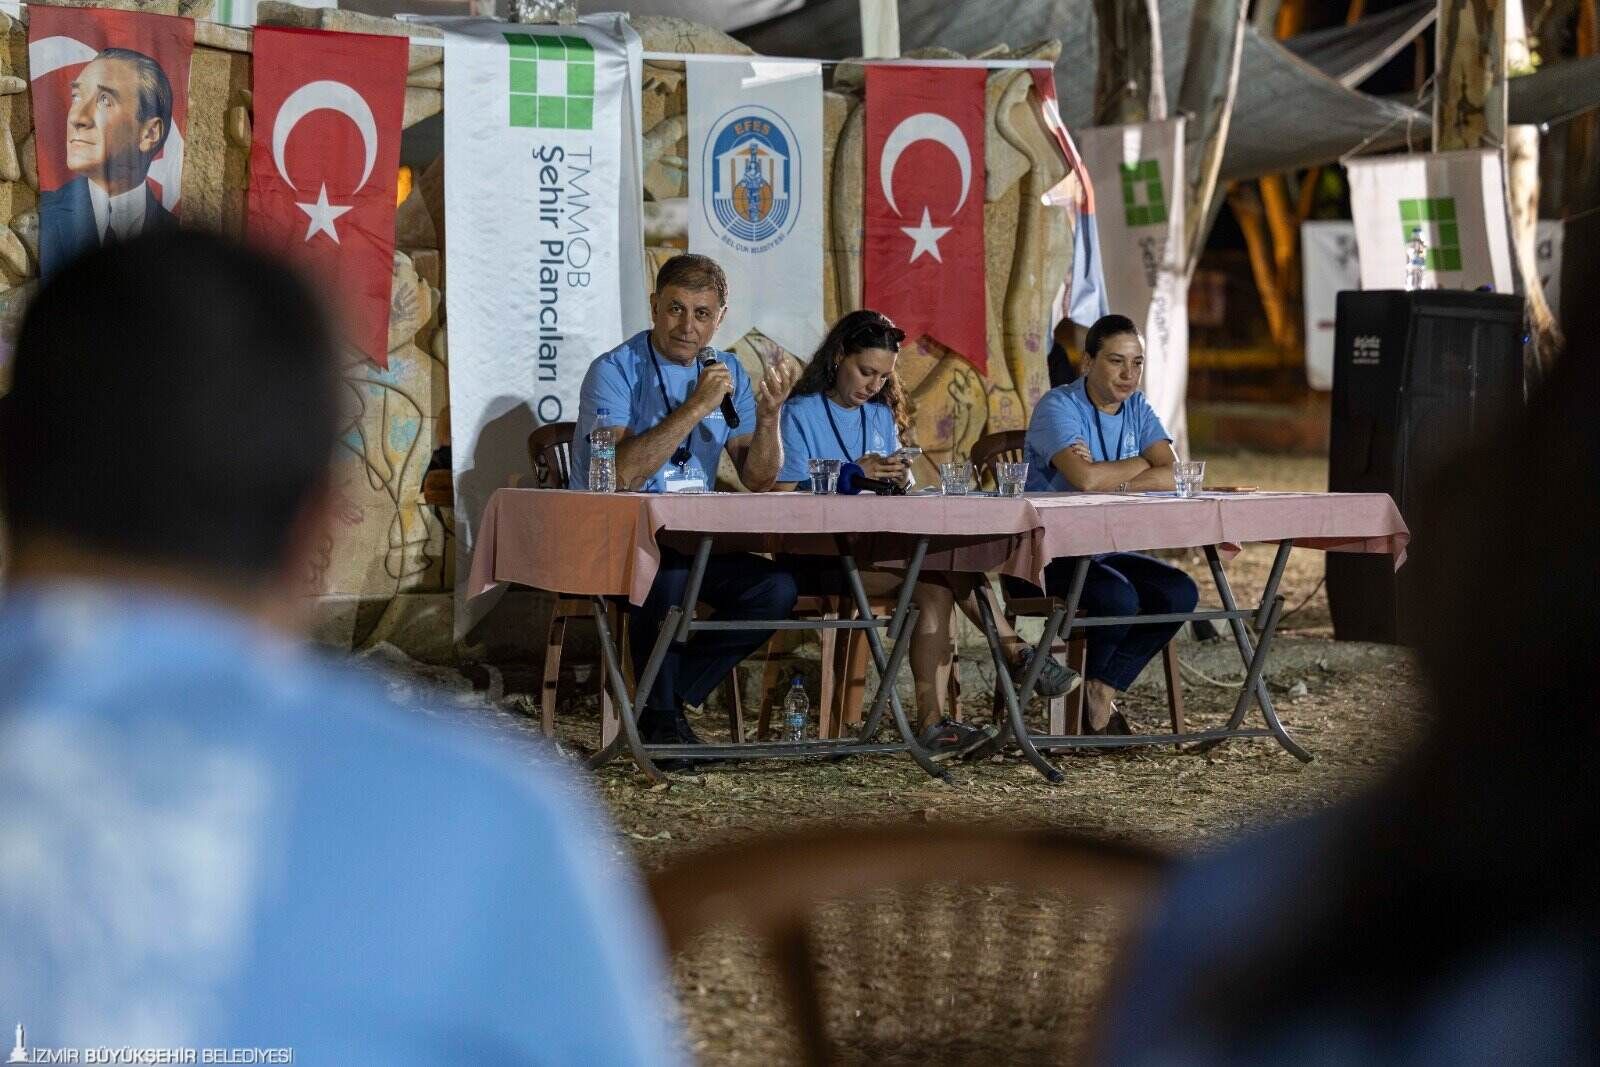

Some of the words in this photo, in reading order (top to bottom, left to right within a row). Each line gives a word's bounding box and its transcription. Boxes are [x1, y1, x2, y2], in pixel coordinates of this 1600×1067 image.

[532, 144, 564, 230] Şehir
[566, 146, 592, 288] TMMOB
[537, 239, 564, 382] Plancıları
